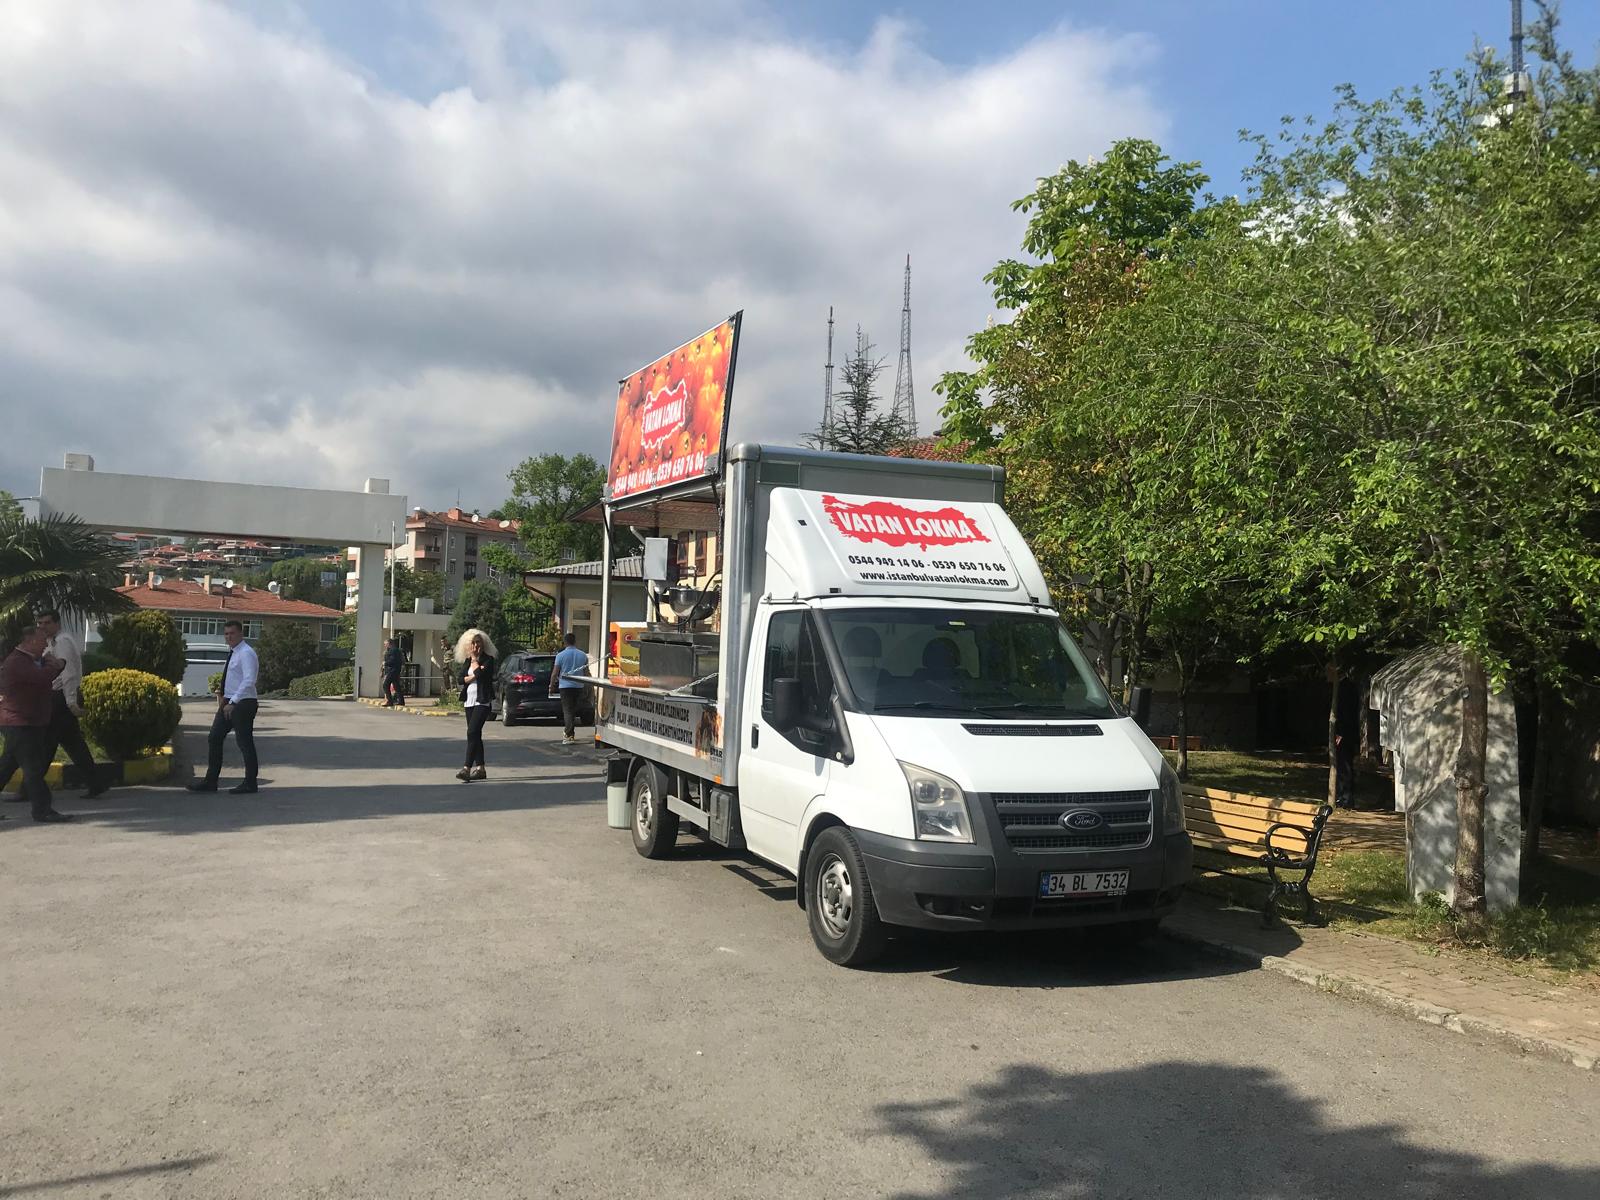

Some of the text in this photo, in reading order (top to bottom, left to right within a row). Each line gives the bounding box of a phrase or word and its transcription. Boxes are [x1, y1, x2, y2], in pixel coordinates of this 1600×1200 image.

[645, 398, 682, 433] VATAN LOKMA
[657, 461, 672, 481] 0539
[673, 457, 685, 478] 650
[695, 451, 704, 471] 06
[837, 511, 976, 539] VATAN LOKMA
[848, 555, 874, 566] 0544
[875, 556, 895, 567] 942
[897, 558, 910, 567] 14
[911, 559, 925, 568] 06
[932, 560, 956, 570] 0539
[959, 561, 977, 571] 650
[978, 562, 992, 572] 76
[993, 562, 1006, 572] 06
[859, 570, 1009, 587] www.istanbulvatanlokma.com
[1074, 814, 1096, 825] Ford
[1050, 875, 1066, 892] 34
[1072, 875, 1088, 891] BL
[1095, 872, 1127, 890] 7532
